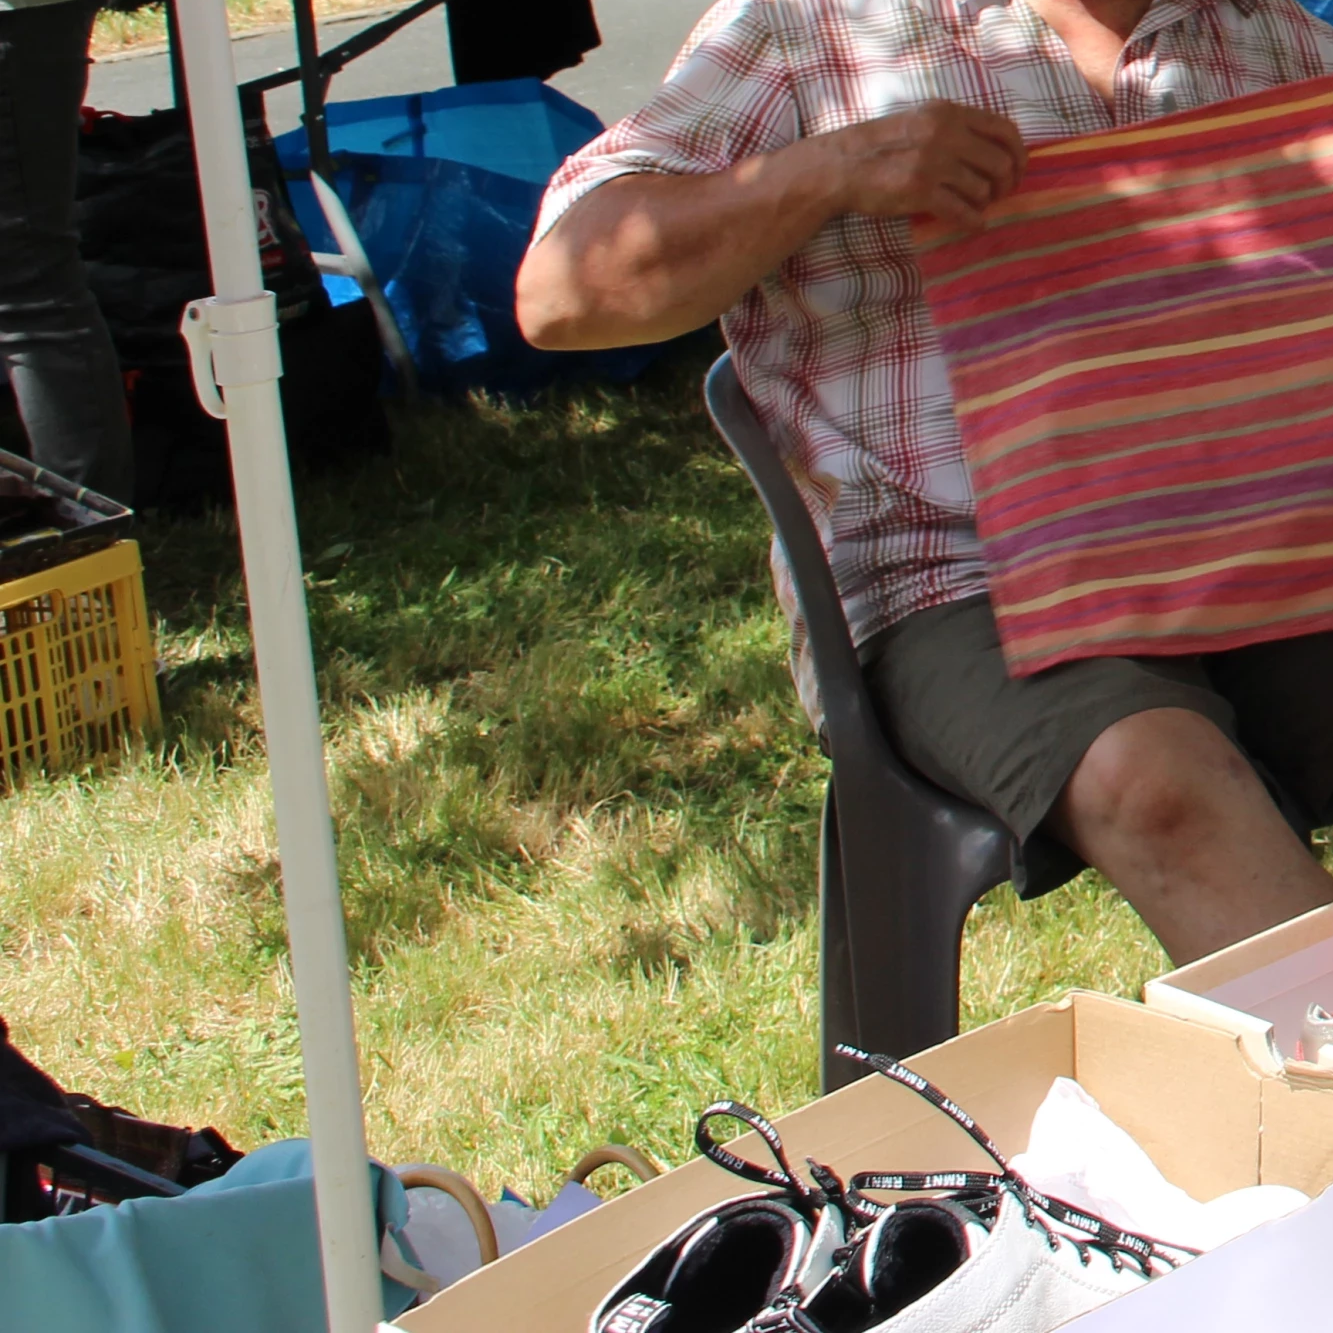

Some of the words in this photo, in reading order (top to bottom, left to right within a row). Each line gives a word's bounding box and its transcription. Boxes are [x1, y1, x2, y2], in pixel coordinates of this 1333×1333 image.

[888, 1063, 928, 1091] RMNT
[941, 1098, 974, 1129] RMNT
[708, 1143, 746, 1170] RMNT
[864, 1176, 904, 1189] RMNT
[924, 1174, 968, 1189] RMNT
[1064, 1210, 1100, 1234] RMNT
[1118, 1233, 1151, 1258] RMNT
